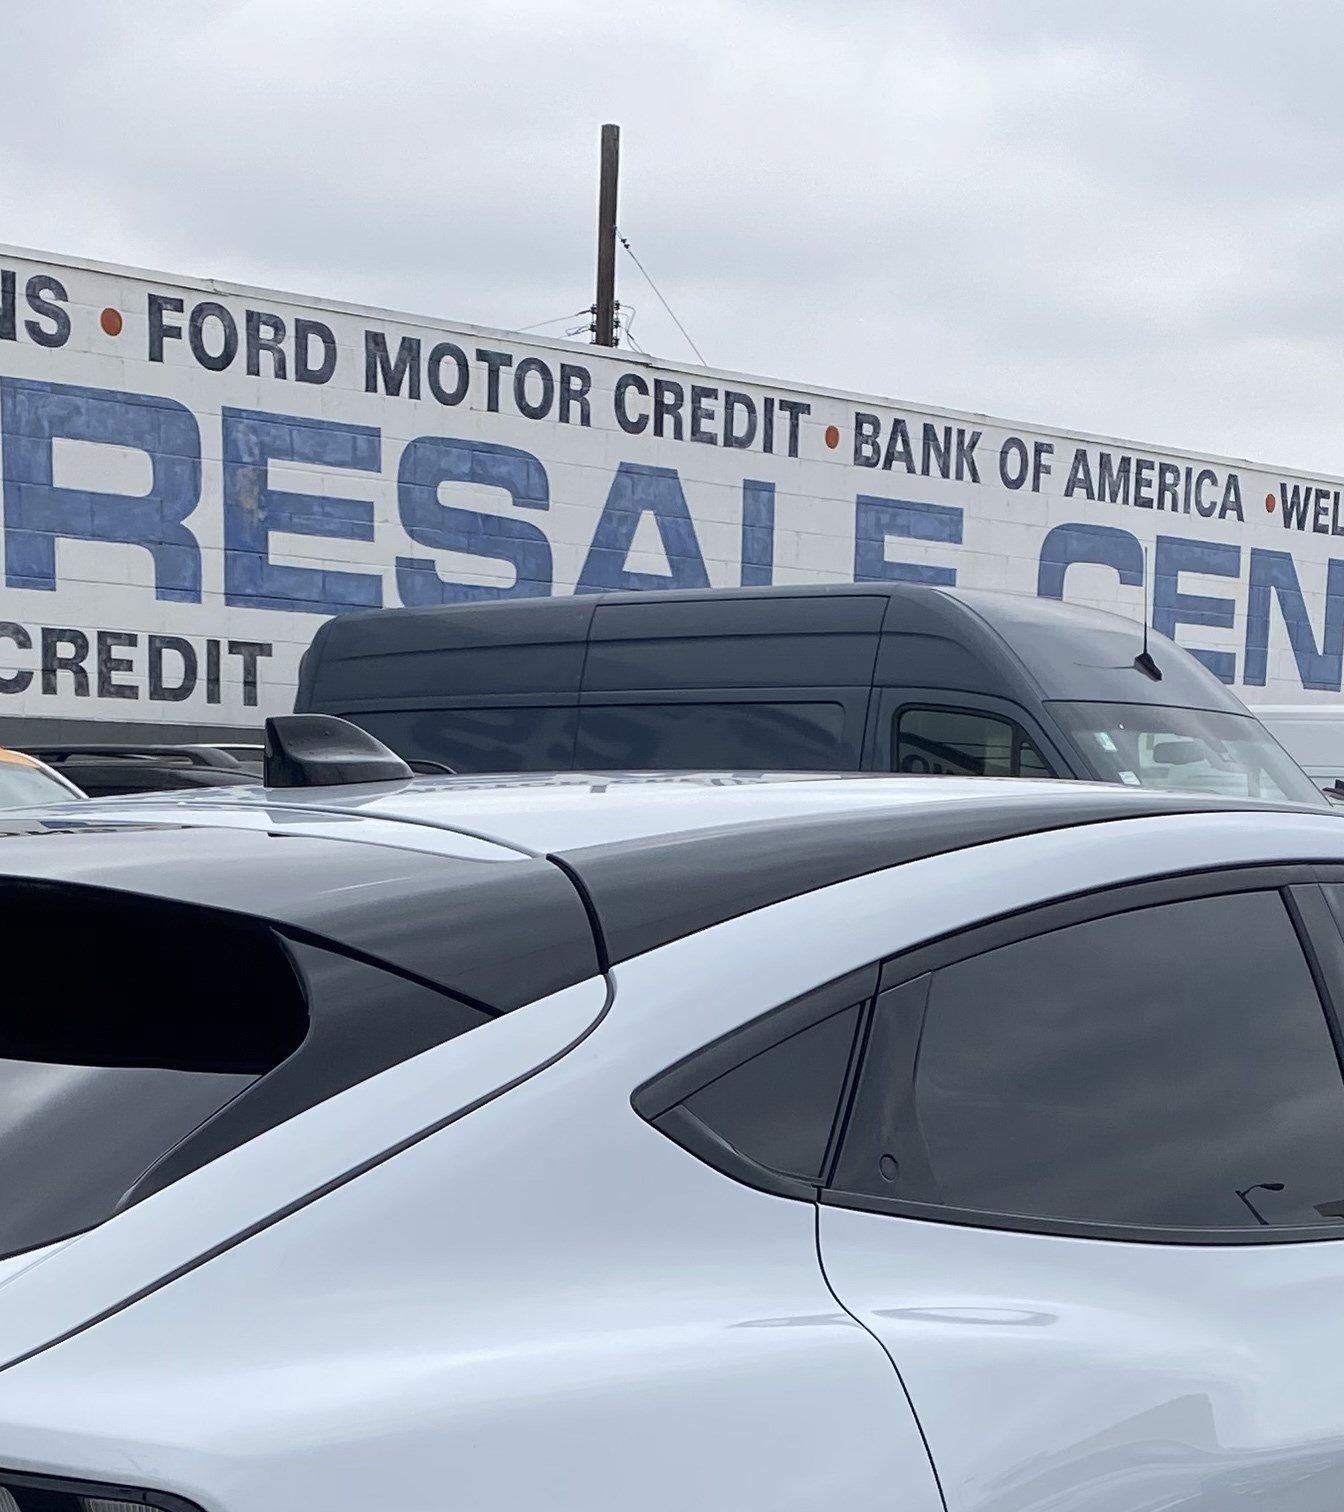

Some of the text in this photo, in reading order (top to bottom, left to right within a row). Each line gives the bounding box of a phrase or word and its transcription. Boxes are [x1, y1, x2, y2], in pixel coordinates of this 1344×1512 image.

[147, 293, 337, 386] FORD
[364, 329, 592, 428] MOTOR
[614, 373, 812, 459] CREDIT
[853, 411, 982, 484] BANK
[999, 436, 1055, 493] OF
[1064, 448, 1246, 523] AMERICA
